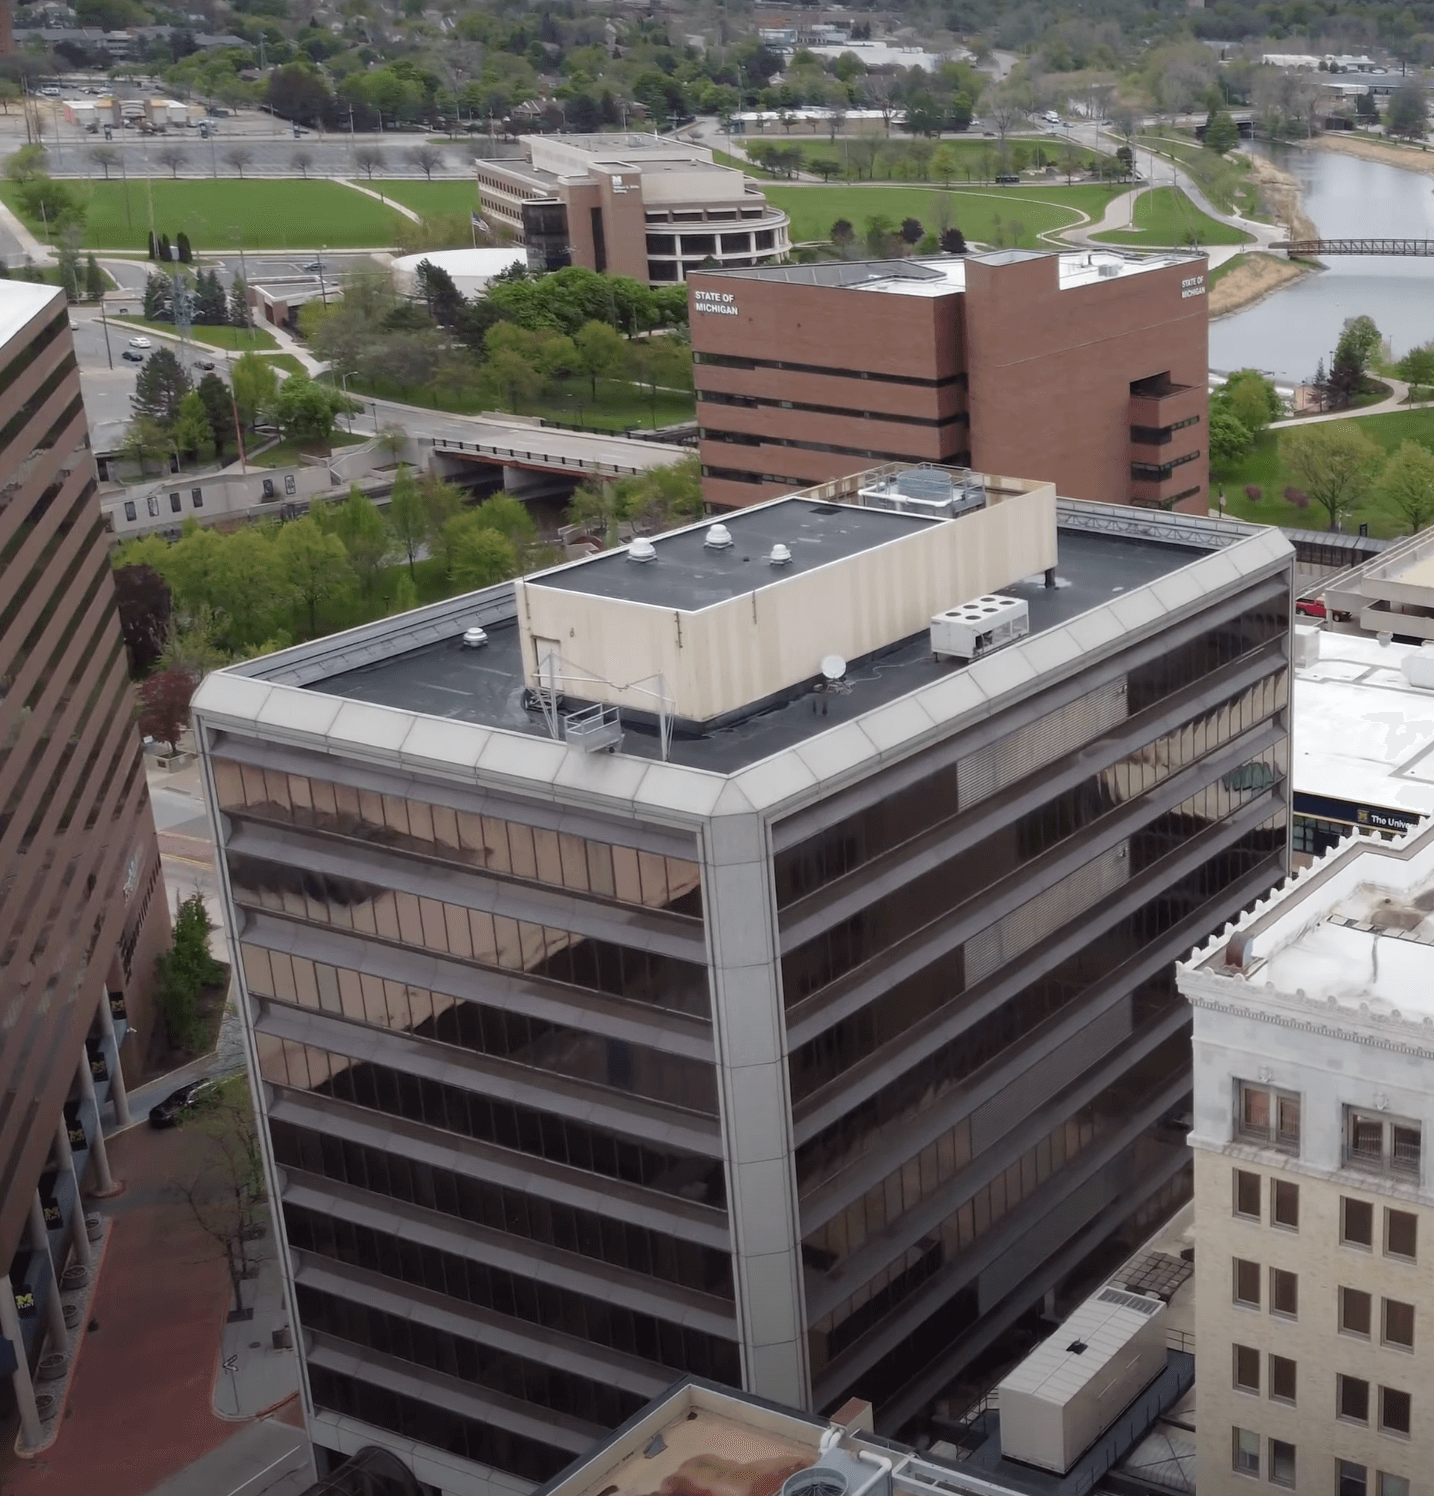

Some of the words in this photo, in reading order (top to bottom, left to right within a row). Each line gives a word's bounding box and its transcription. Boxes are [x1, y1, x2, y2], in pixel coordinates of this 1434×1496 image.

[1182, 277, 1196, 288] STATE
[1197, 275, 1204, 285] OF
[695, 291, 721, 302] STATE
[722, 293, 735, 303] OF
[1182, 287, 1206, 298] MICHIGAN
[696, 302, 739, 315] MICHIGAN
[1371, 814, 1387, 825] The
[15, 1293, 34, 1305] M
